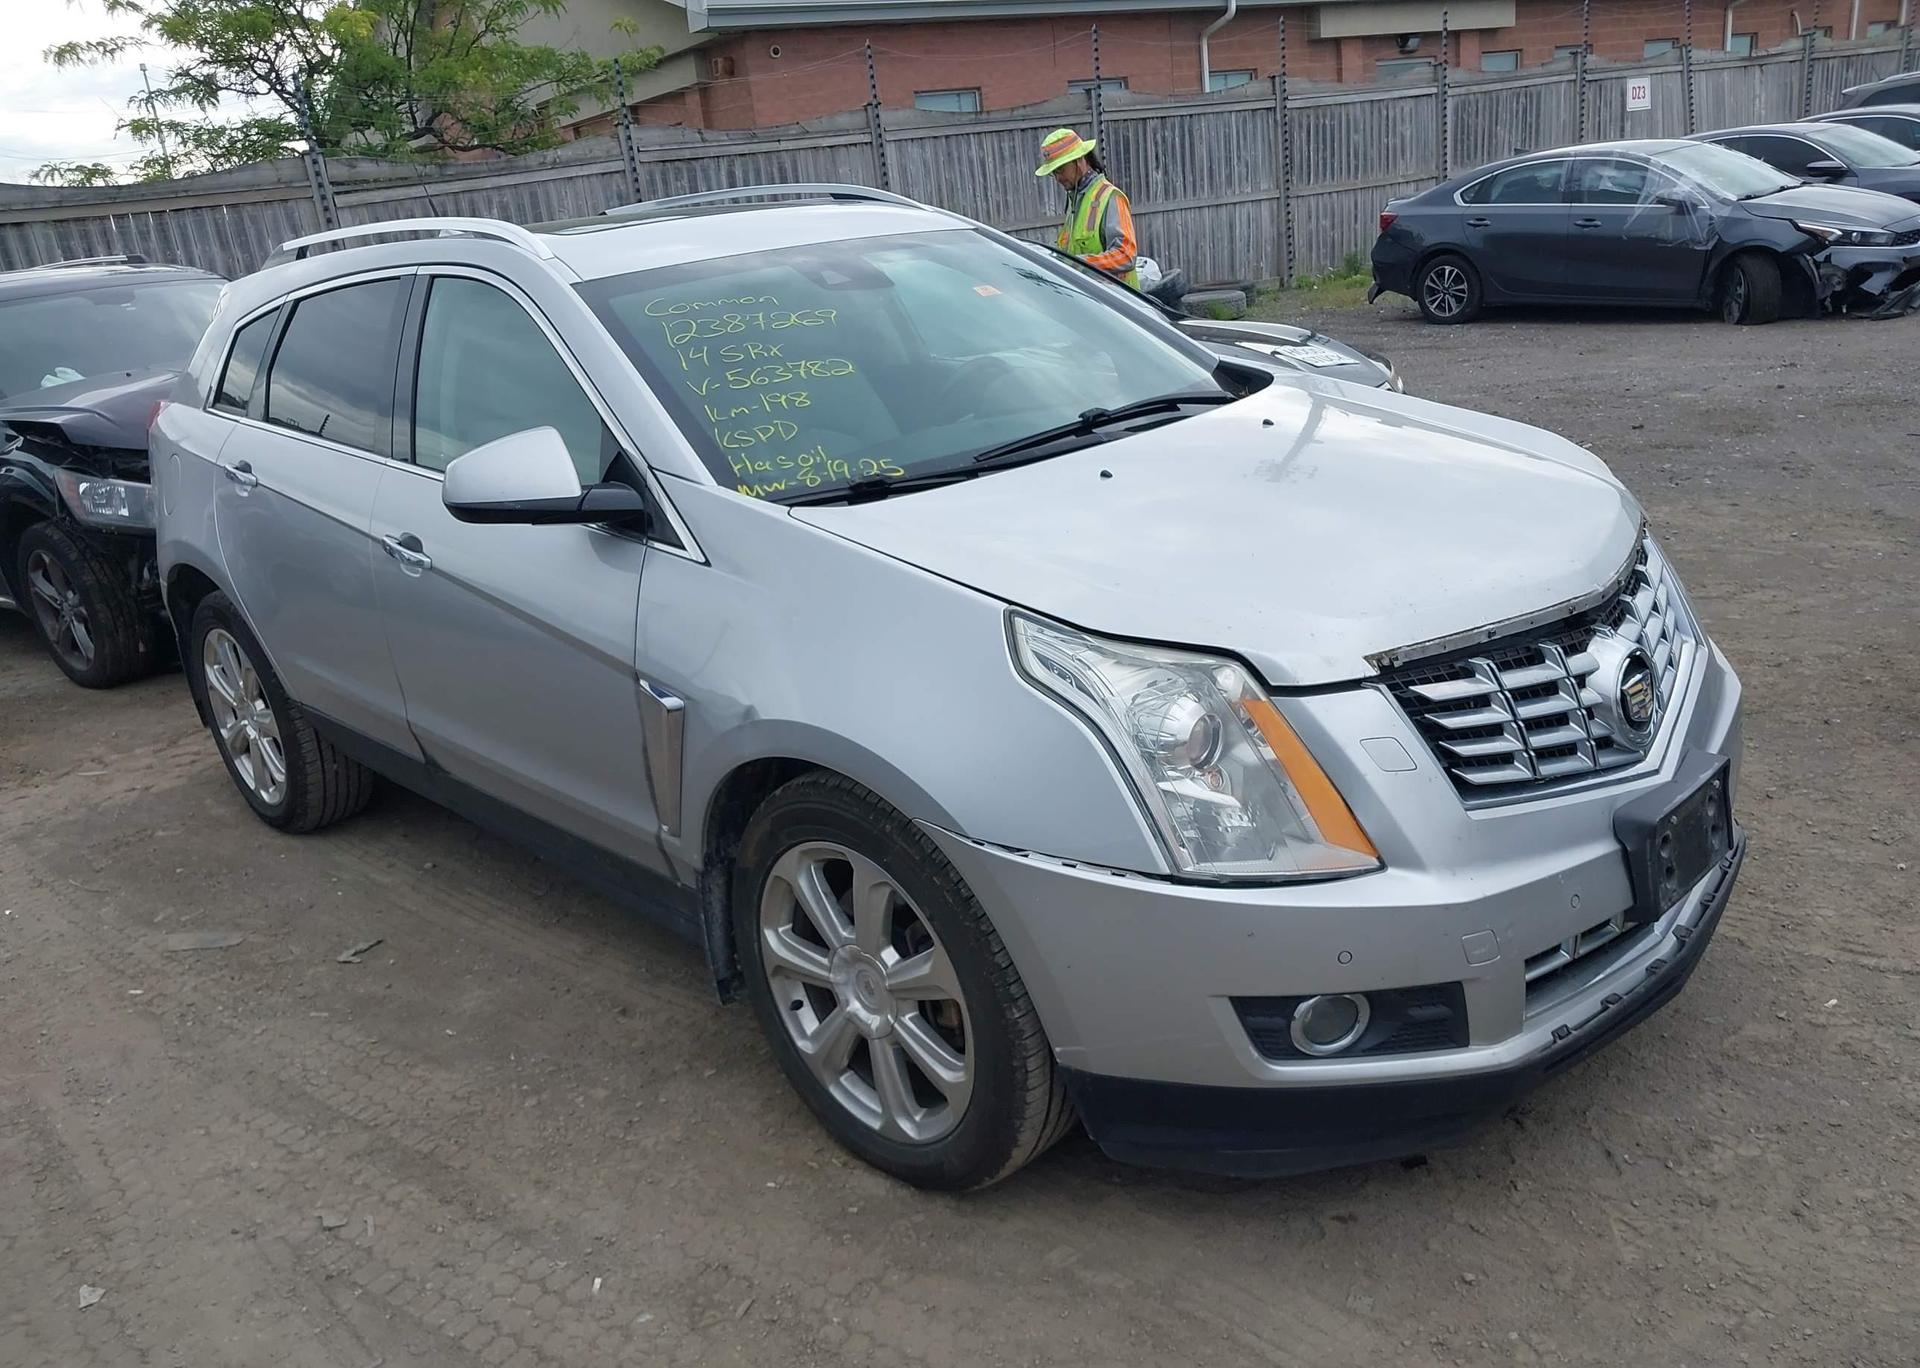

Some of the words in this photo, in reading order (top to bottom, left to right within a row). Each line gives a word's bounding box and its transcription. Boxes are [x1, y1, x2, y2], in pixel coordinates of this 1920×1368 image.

[644, 296, 780, 317] Common
[661, 308, 837, 349] 12387269
[677, 346, 709, 371] 14
